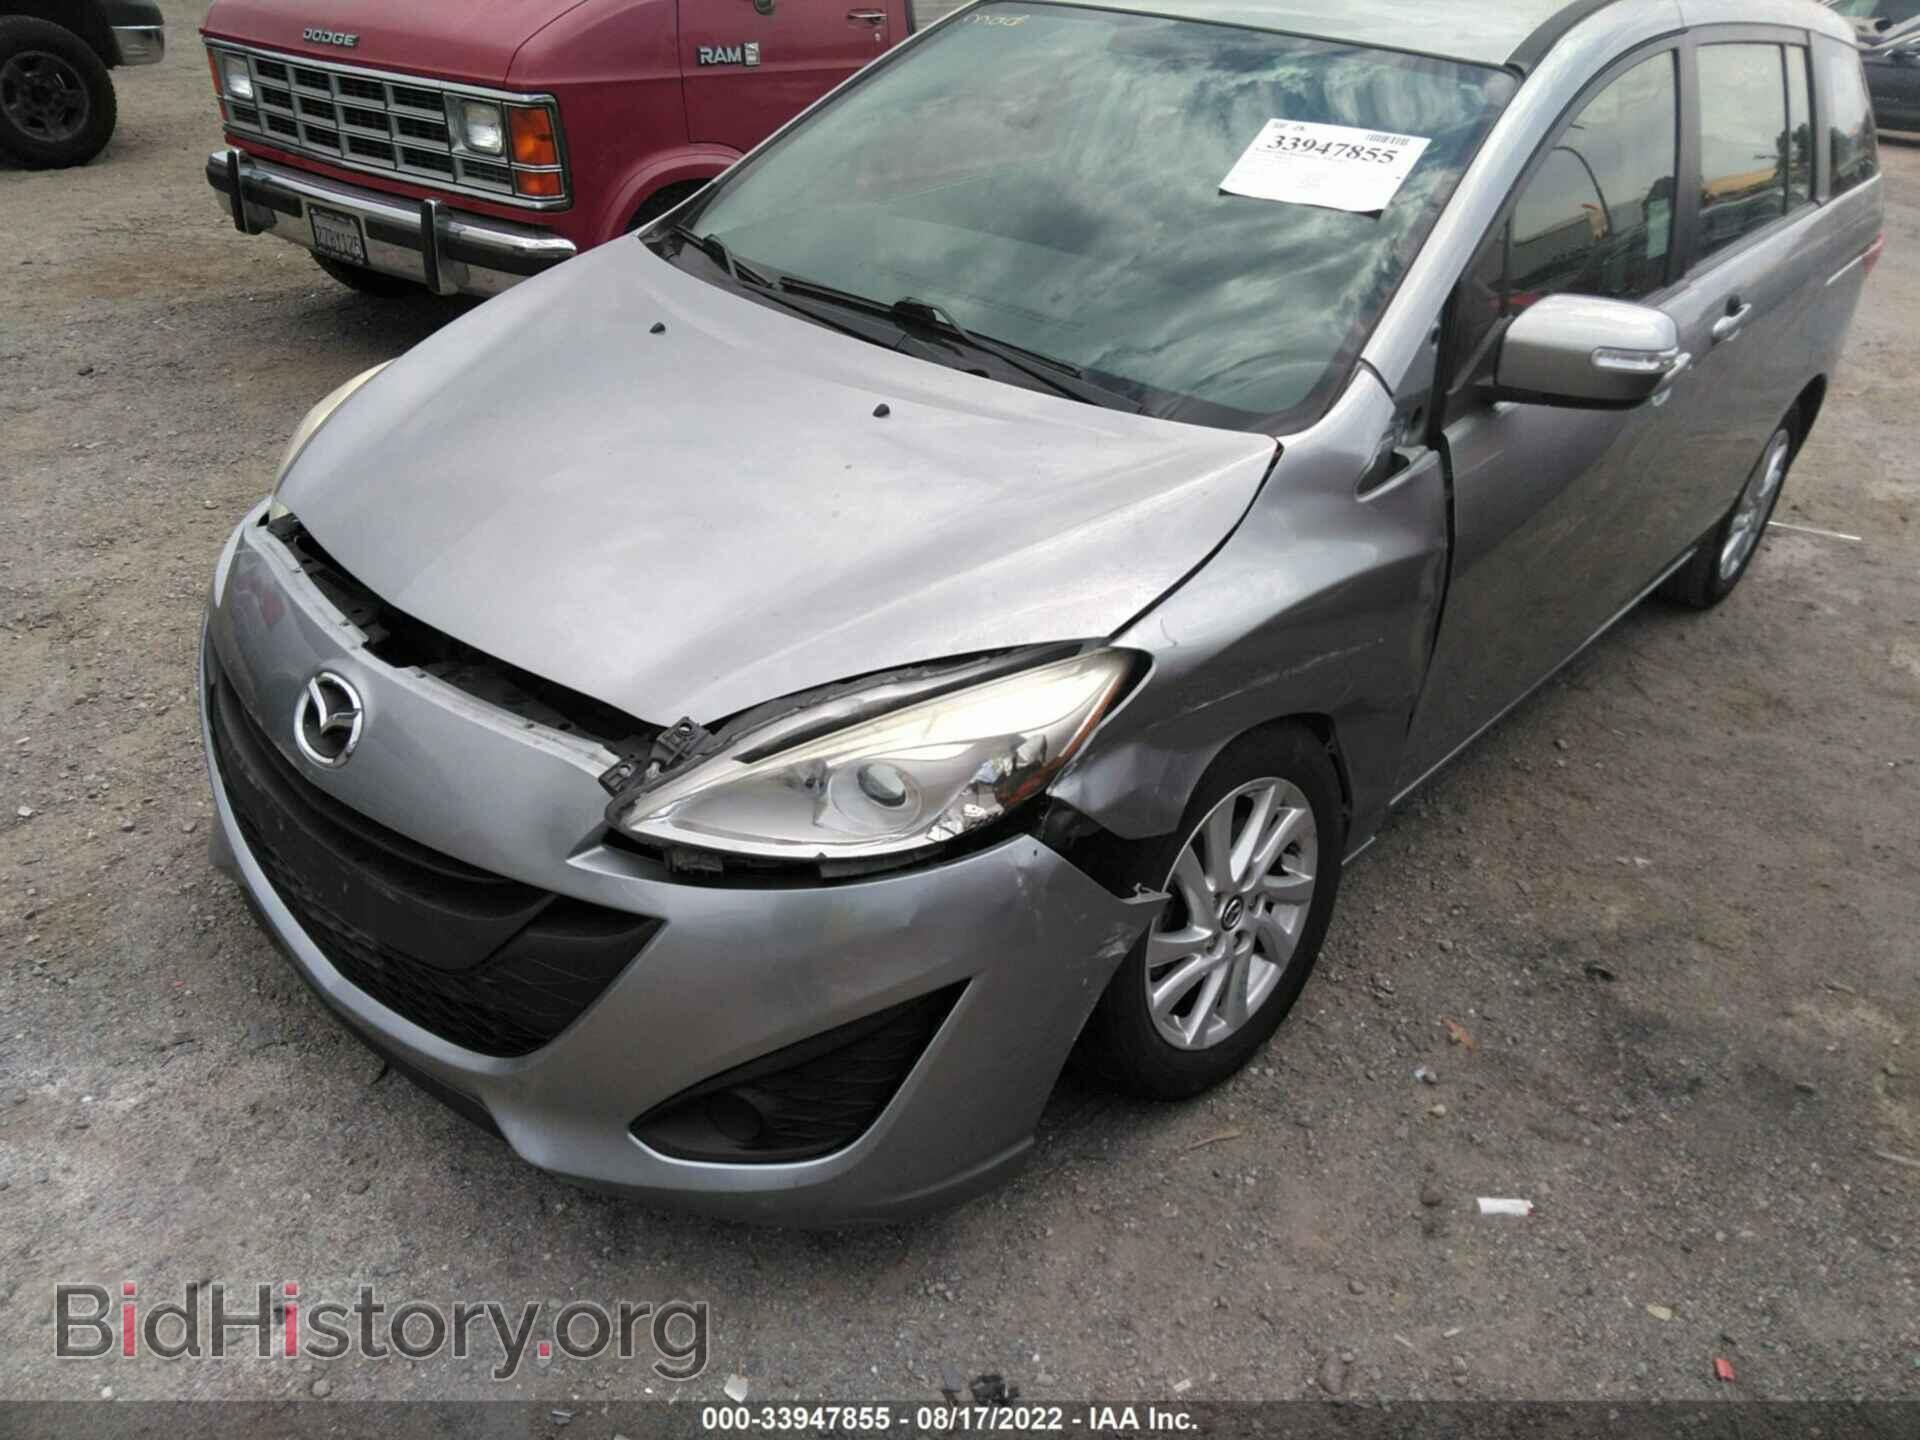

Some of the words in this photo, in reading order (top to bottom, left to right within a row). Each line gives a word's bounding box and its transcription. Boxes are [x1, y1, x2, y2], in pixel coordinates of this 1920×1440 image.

[303, 28, 358, 46] DODGE
[700, 46, 742, 64] RAM
[1266, 135, 1398, 164] 33947855
